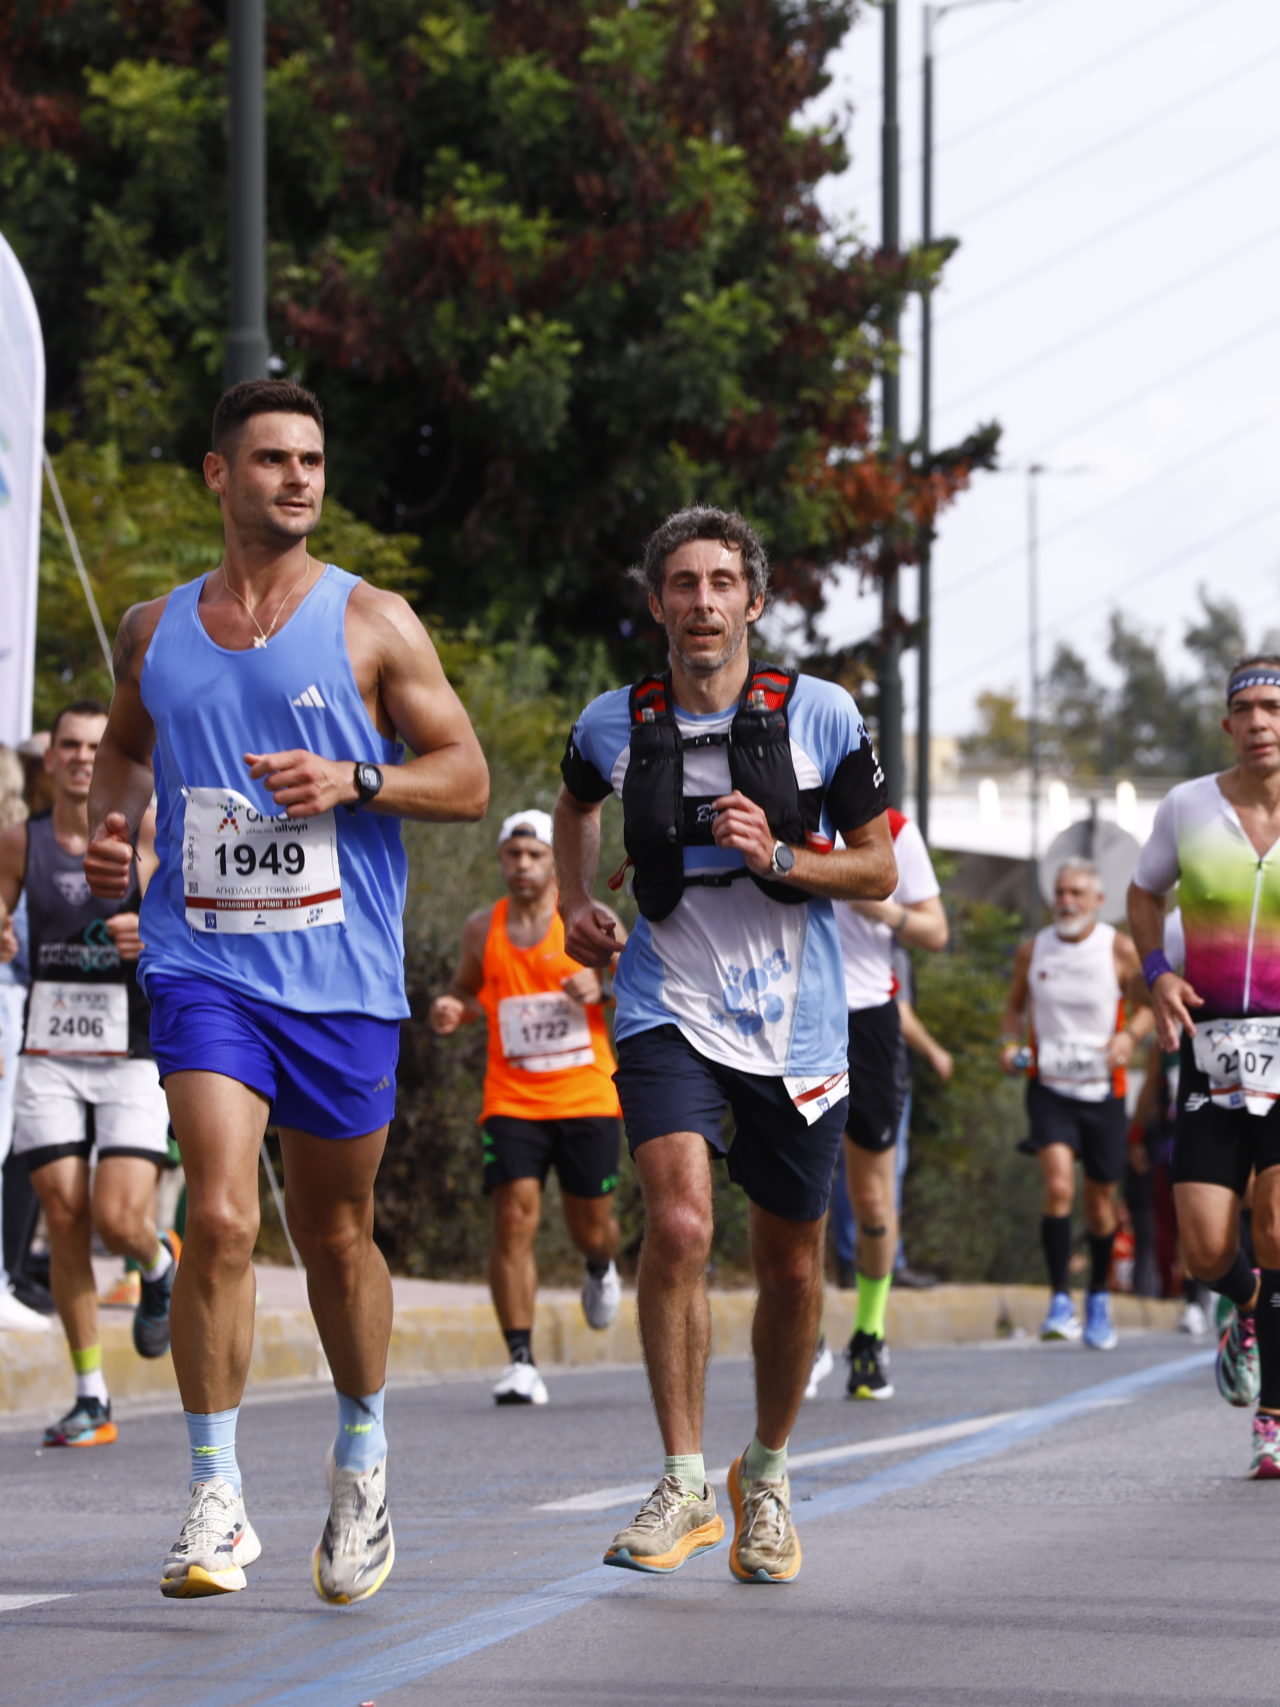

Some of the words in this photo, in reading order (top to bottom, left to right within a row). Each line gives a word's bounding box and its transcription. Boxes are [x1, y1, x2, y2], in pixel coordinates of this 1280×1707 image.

[215, 842, 305, 877] 1949
[49, 1016, 103, 1037] 2406
[521, 1020, 568, 1043] 1722
